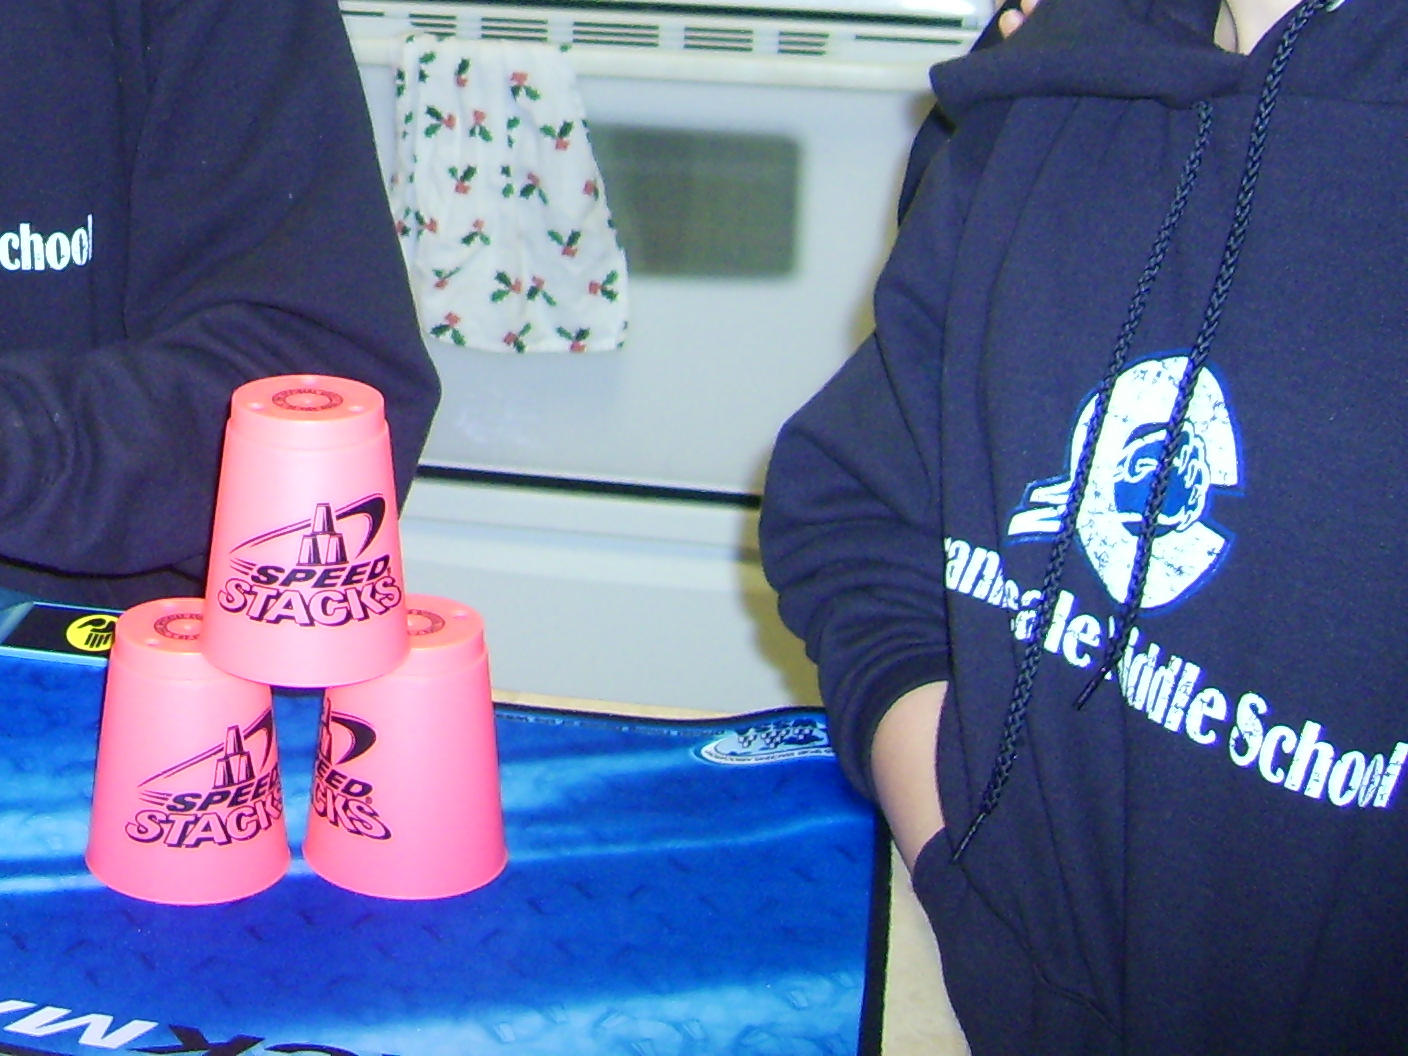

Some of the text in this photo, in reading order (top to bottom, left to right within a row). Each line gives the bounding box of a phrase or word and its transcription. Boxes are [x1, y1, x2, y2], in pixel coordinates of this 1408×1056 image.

[250, 554, 391, 589] SPEED
[217, 575, 403, 627] STACKS
[1105, 614, 1228, 746] iddle
[1228, 690, 1408, 810] School
[124, 790, 284, 849] STACK
